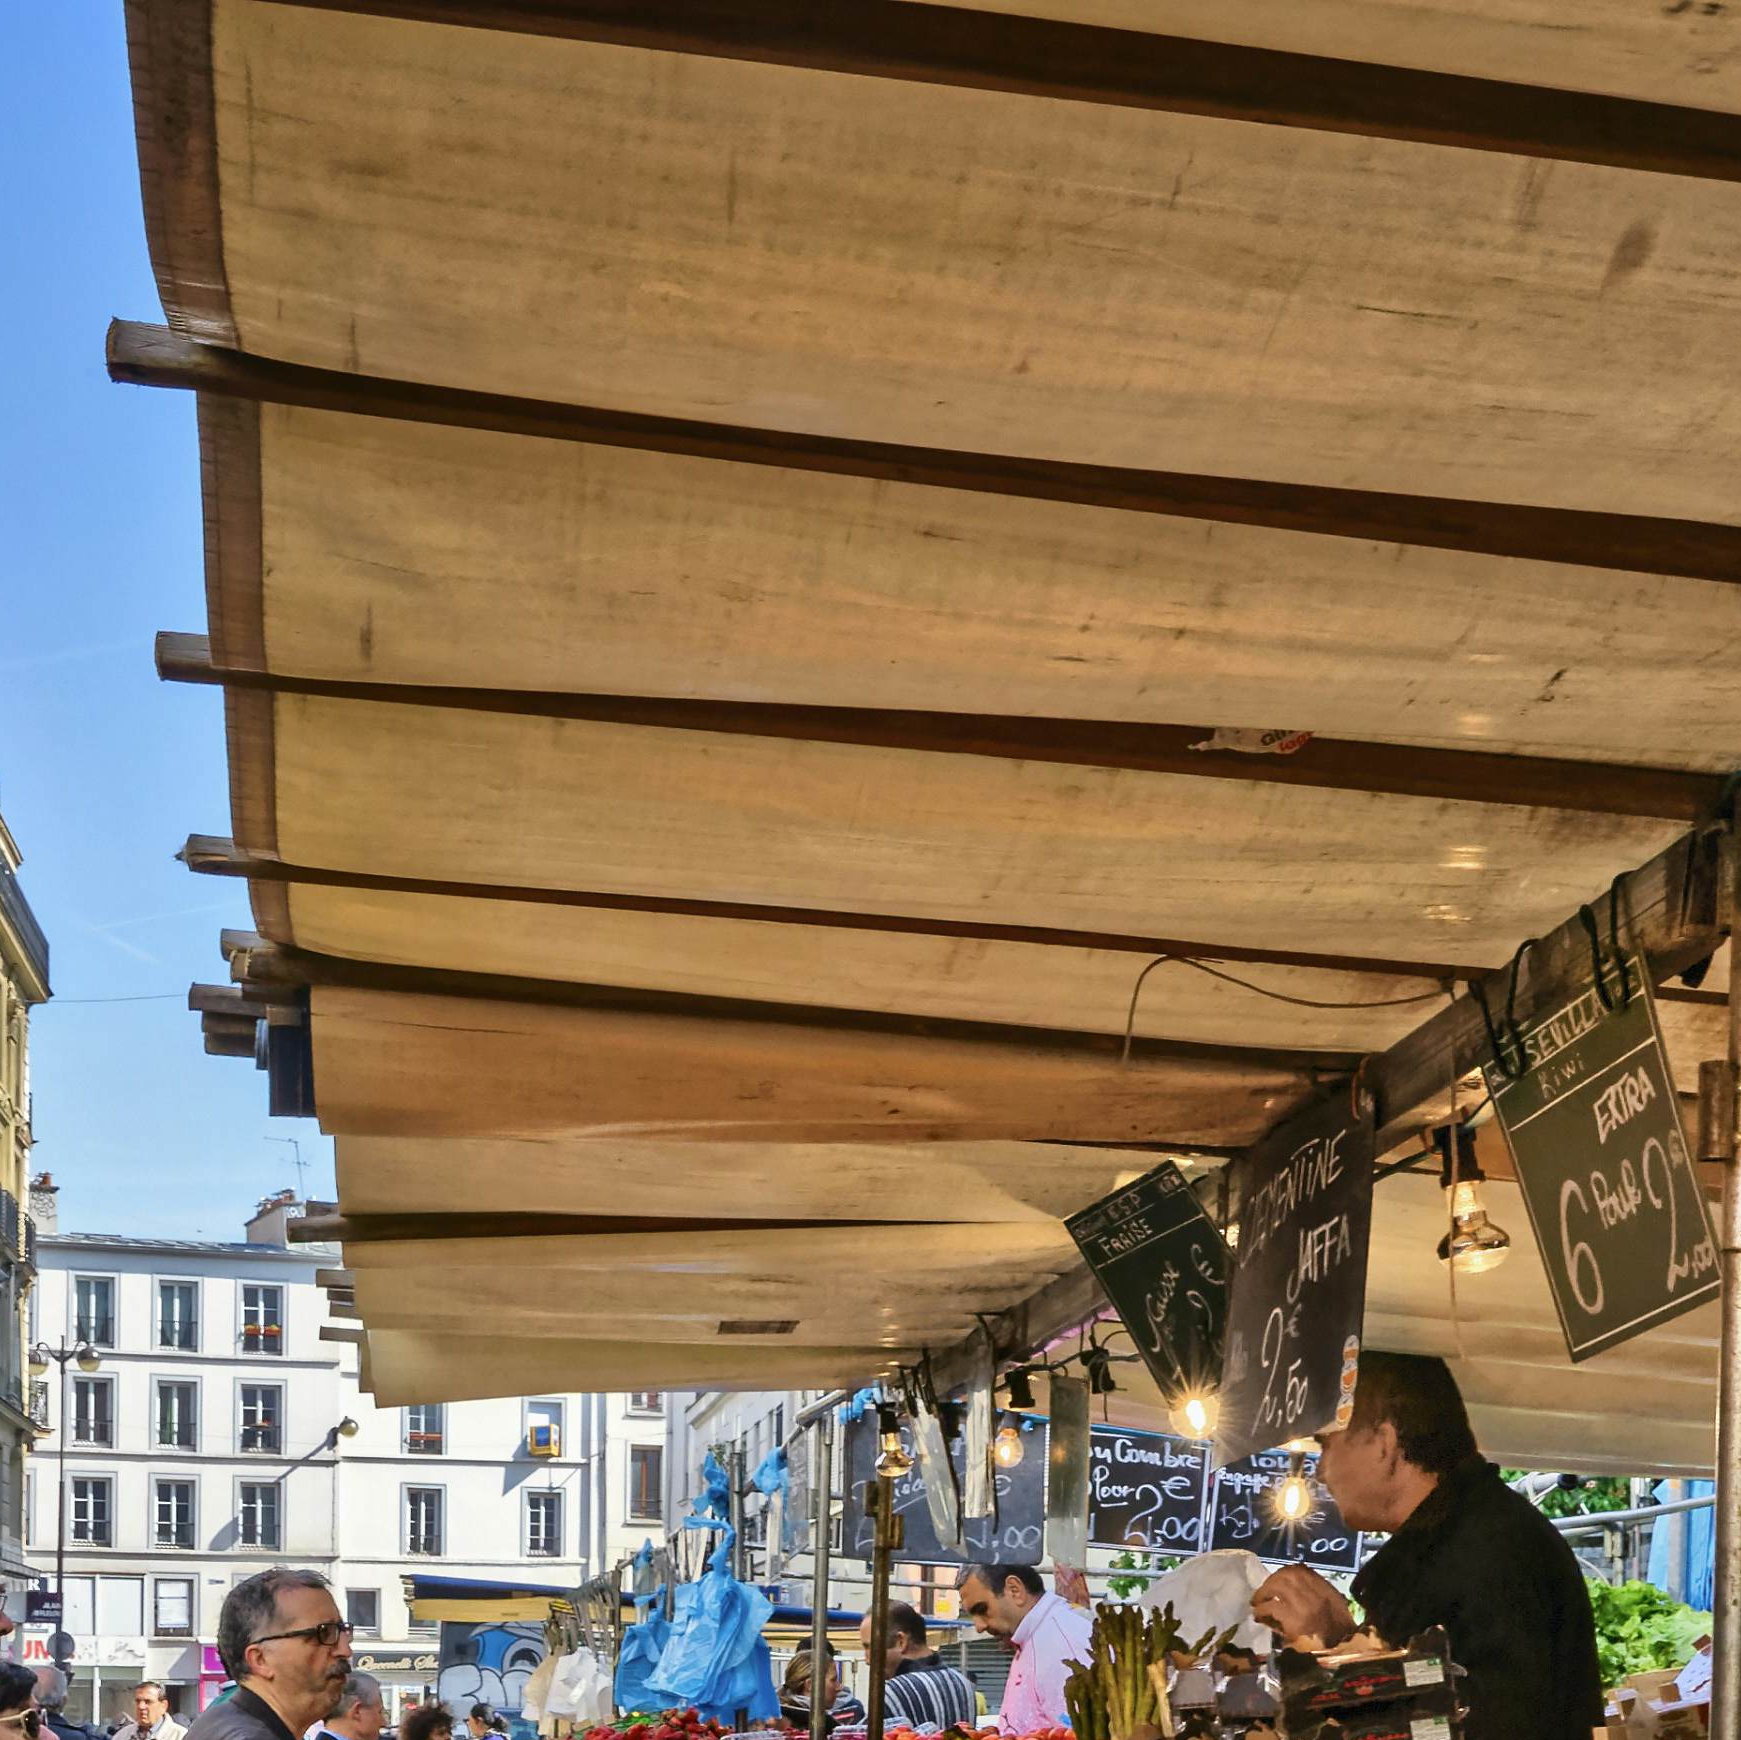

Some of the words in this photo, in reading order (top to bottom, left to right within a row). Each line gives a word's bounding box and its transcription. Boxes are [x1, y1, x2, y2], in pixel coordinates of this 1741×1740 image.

[1592, 1065, 1657, 1145] EXTRA
[1559, 1178, 1605, 1315] 6
[1160, 1475, 1196, 1500] €
